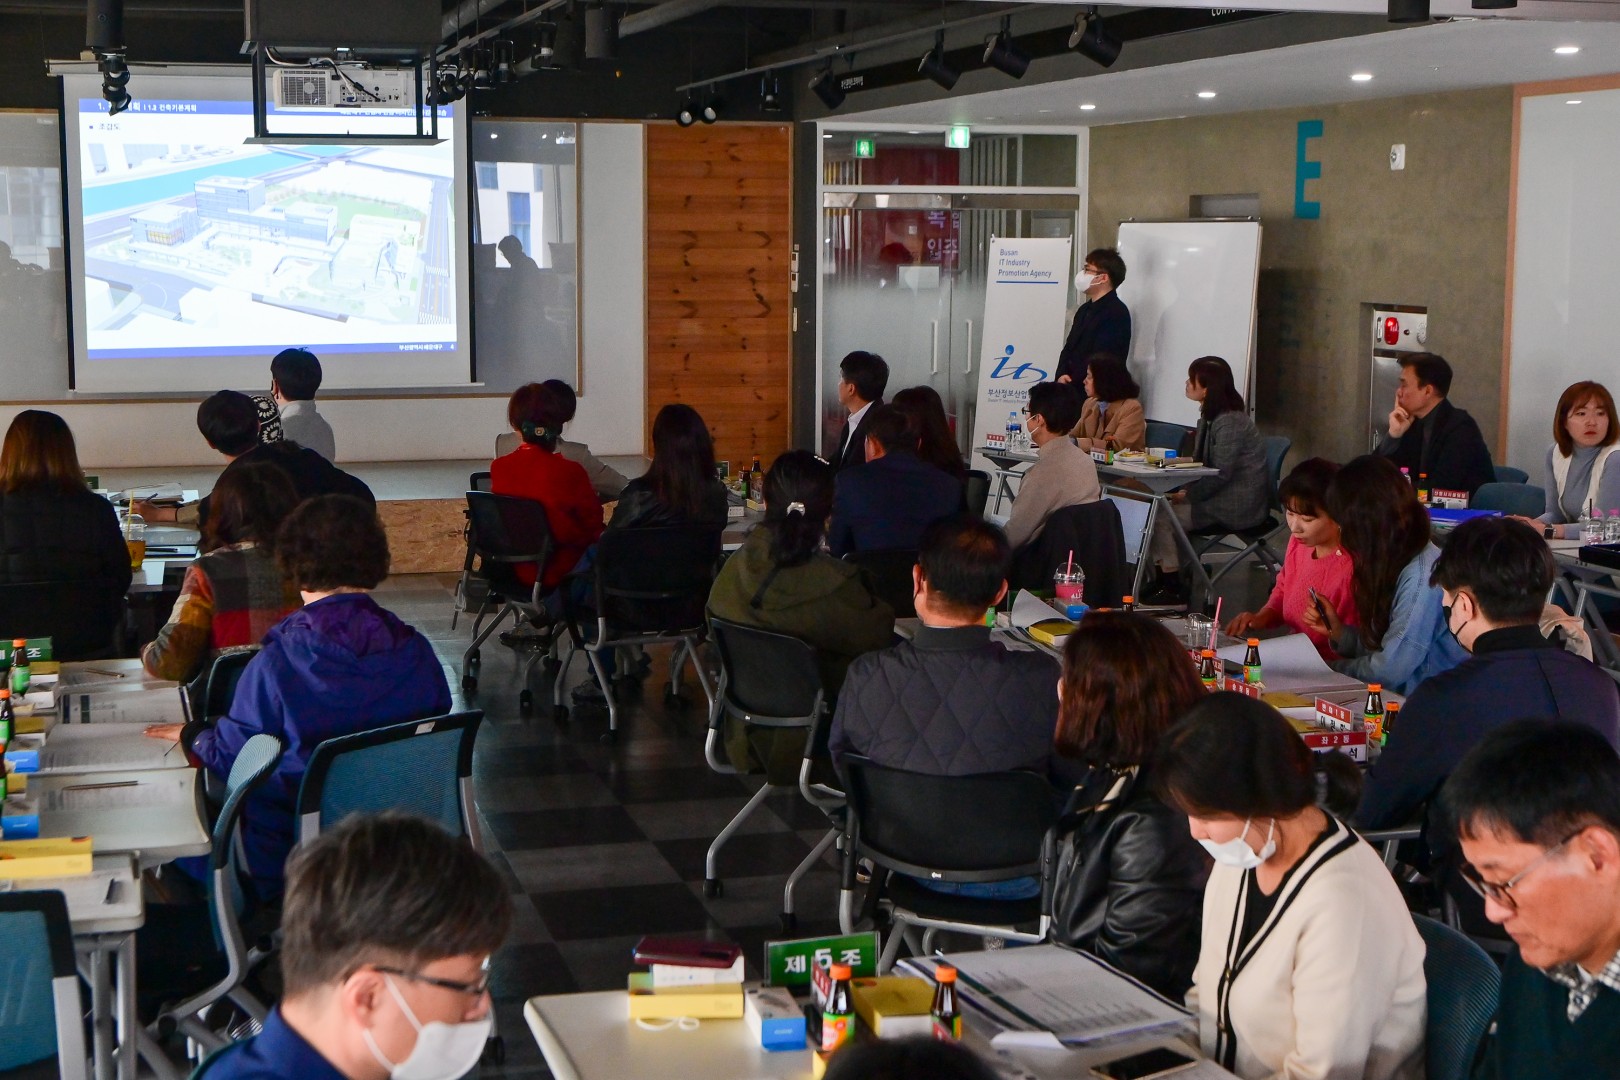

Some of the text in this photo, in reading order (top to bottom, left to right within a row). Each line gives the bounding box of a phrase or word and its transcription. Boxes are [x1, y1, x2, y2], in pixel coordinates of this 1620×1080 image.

[1295, 119, 1323, 219] E
[1000, 248, 1018, 256] Busan
[1006, 259, 1030, 267] Industry
[998, 269, 1052, 278] Promotion Agency
[988, 389, 1028, 399] 부산정보산업
